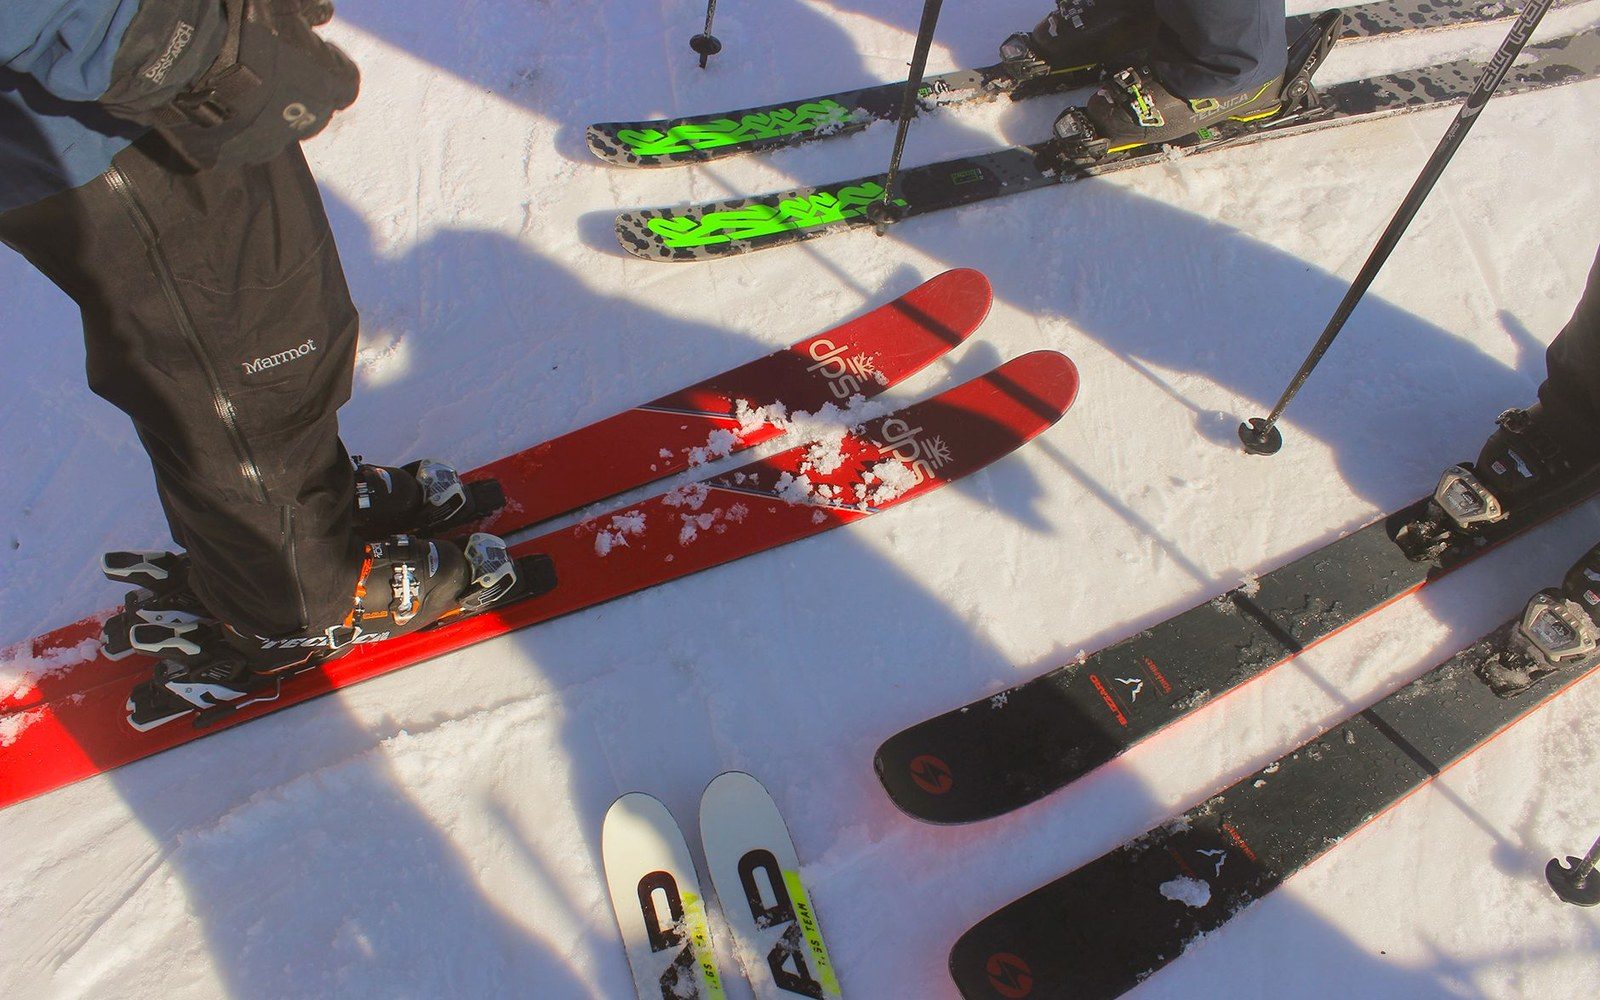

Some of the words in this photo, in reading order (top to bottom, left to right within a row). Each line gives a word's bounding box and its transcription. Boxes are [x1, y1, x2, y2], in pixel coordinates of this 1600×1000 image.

[242, 338, 317, 375] Marmot
[806, 339, 861, 399] dps
[878, 418, 936, 485] dps
[796, 902, 816, 932] TEAM
